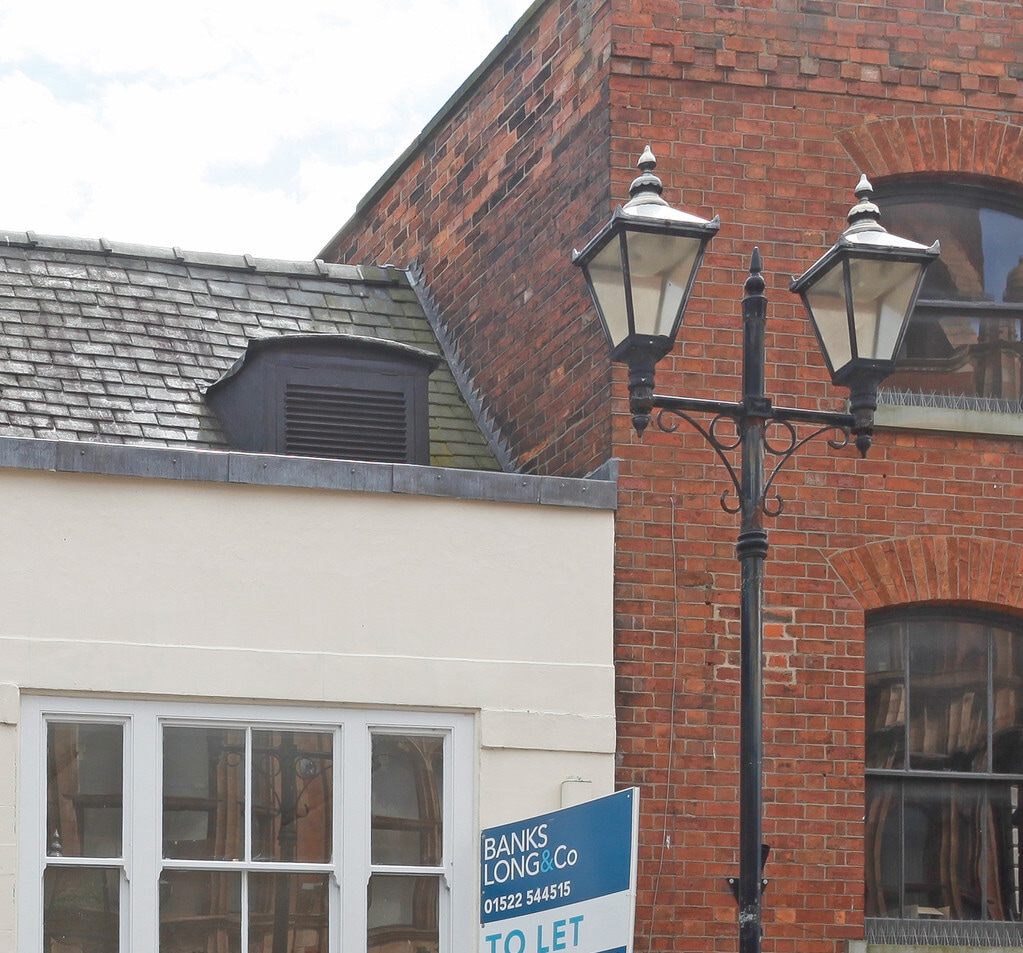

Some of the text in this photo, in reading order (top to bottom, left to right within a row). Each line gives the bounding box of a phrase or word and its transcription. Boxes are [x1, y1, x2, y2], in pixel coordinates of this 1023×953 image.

[484, 824, 548, 860] BANKS
[484, 845, 577, 886] LONG&Co
[484, 881, 570, 914] 01522 544515
[537, 915, 584, 953] LET
